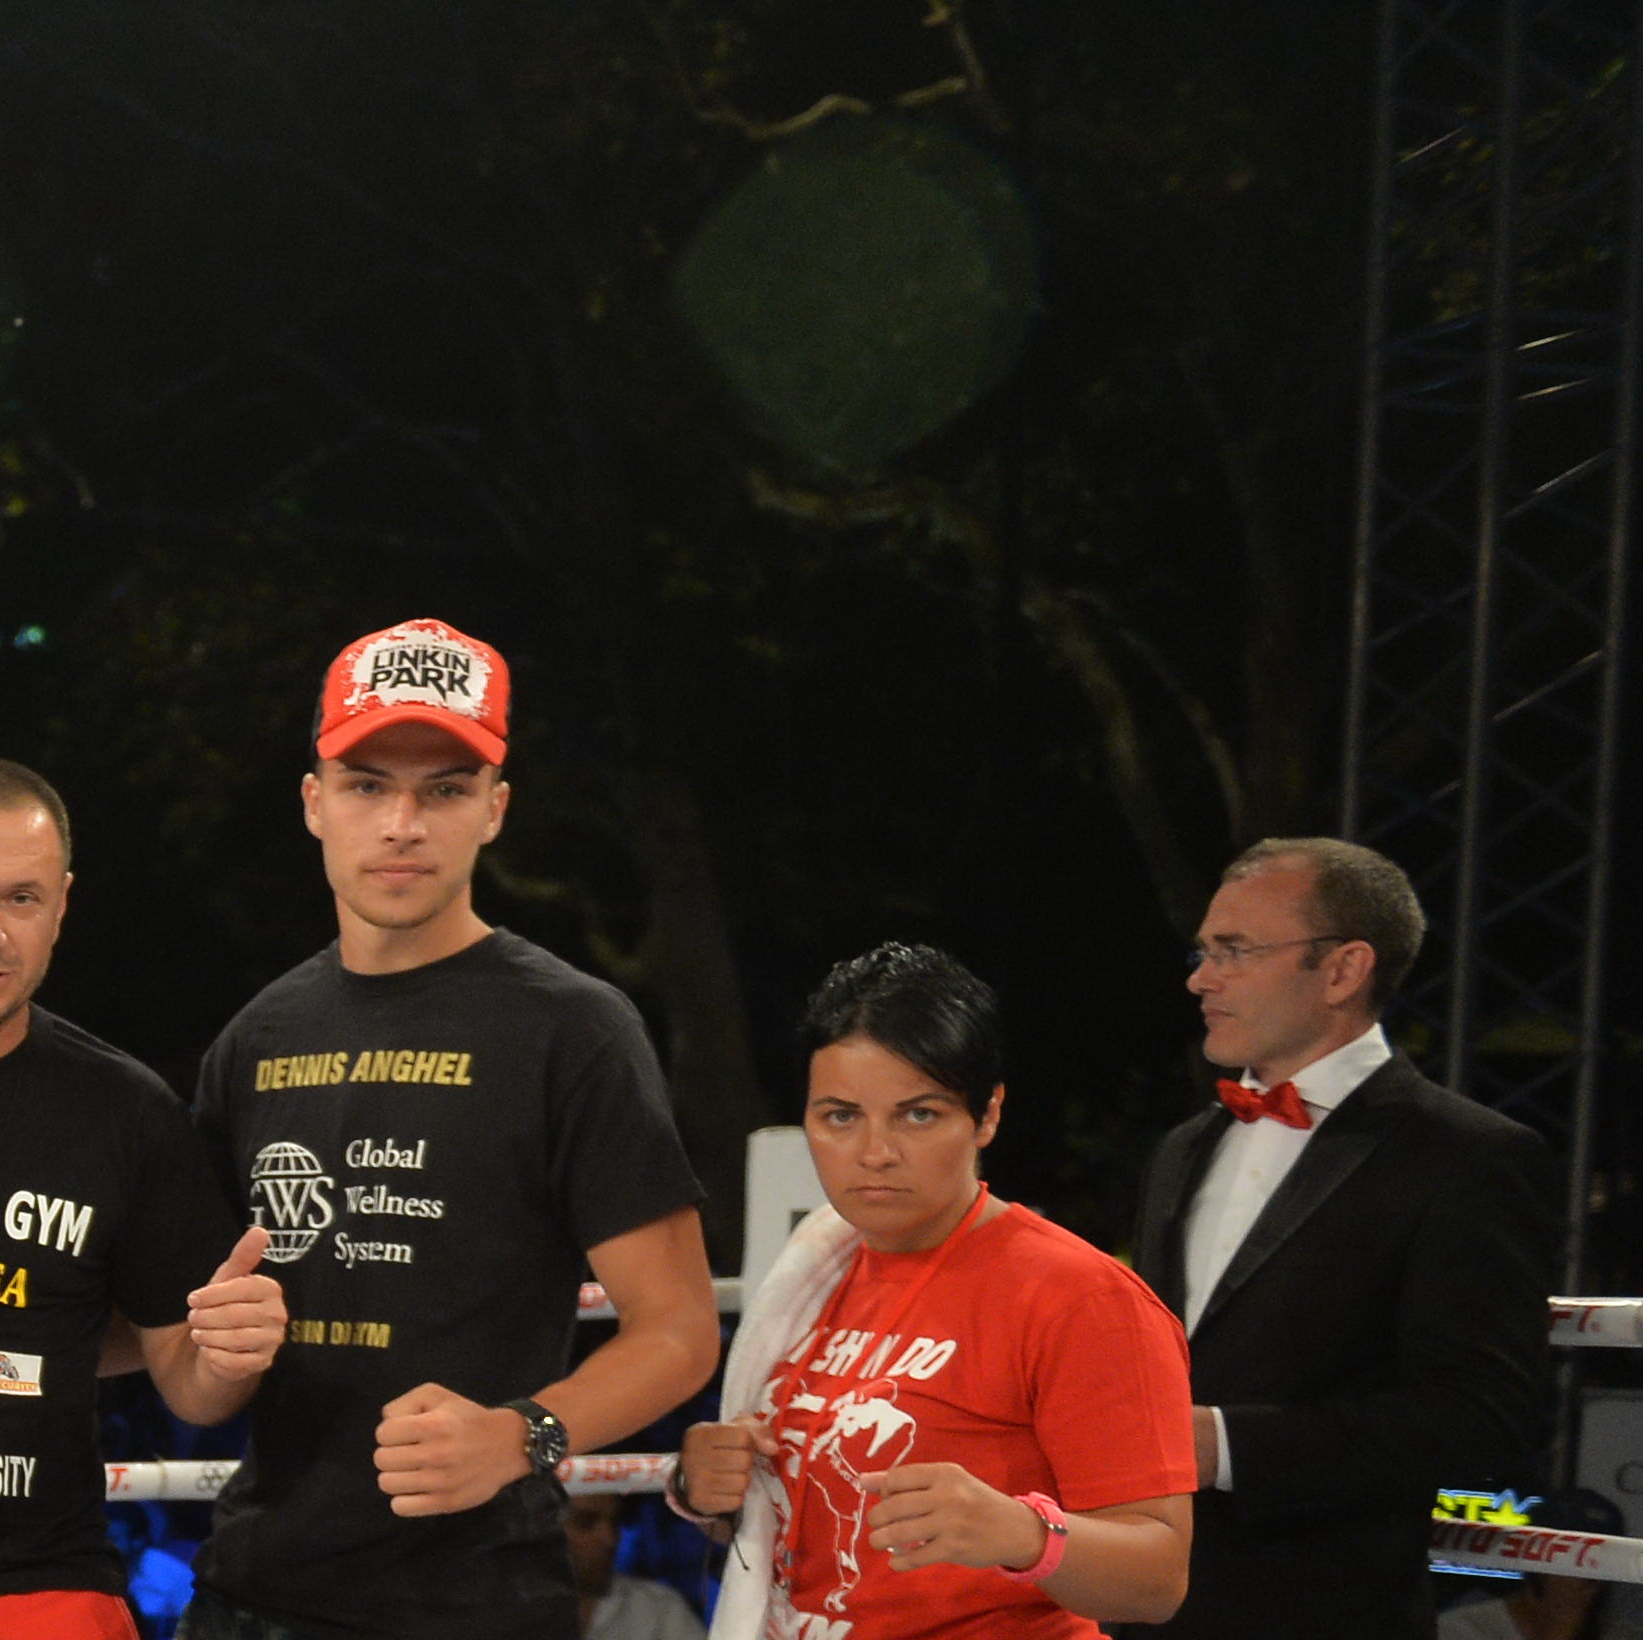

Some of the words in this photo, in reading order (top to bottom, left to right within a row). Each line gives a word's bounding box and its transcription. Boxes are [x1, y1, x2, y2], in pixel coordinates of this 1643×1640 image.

[372, 649, 471, 674] LINKIN
[370, 667, 472, 700] PARK
[255, 1054, 347, 1091] DENNIS
[349, 1050, 472, 1086] ANGHEL
[345, 1138, 427, 1169] Global
[344, 1184, 445, 1219] Wellness
[5, 1189, 94, 1257] GYM
[887, 1336, 957, 1381] DO
